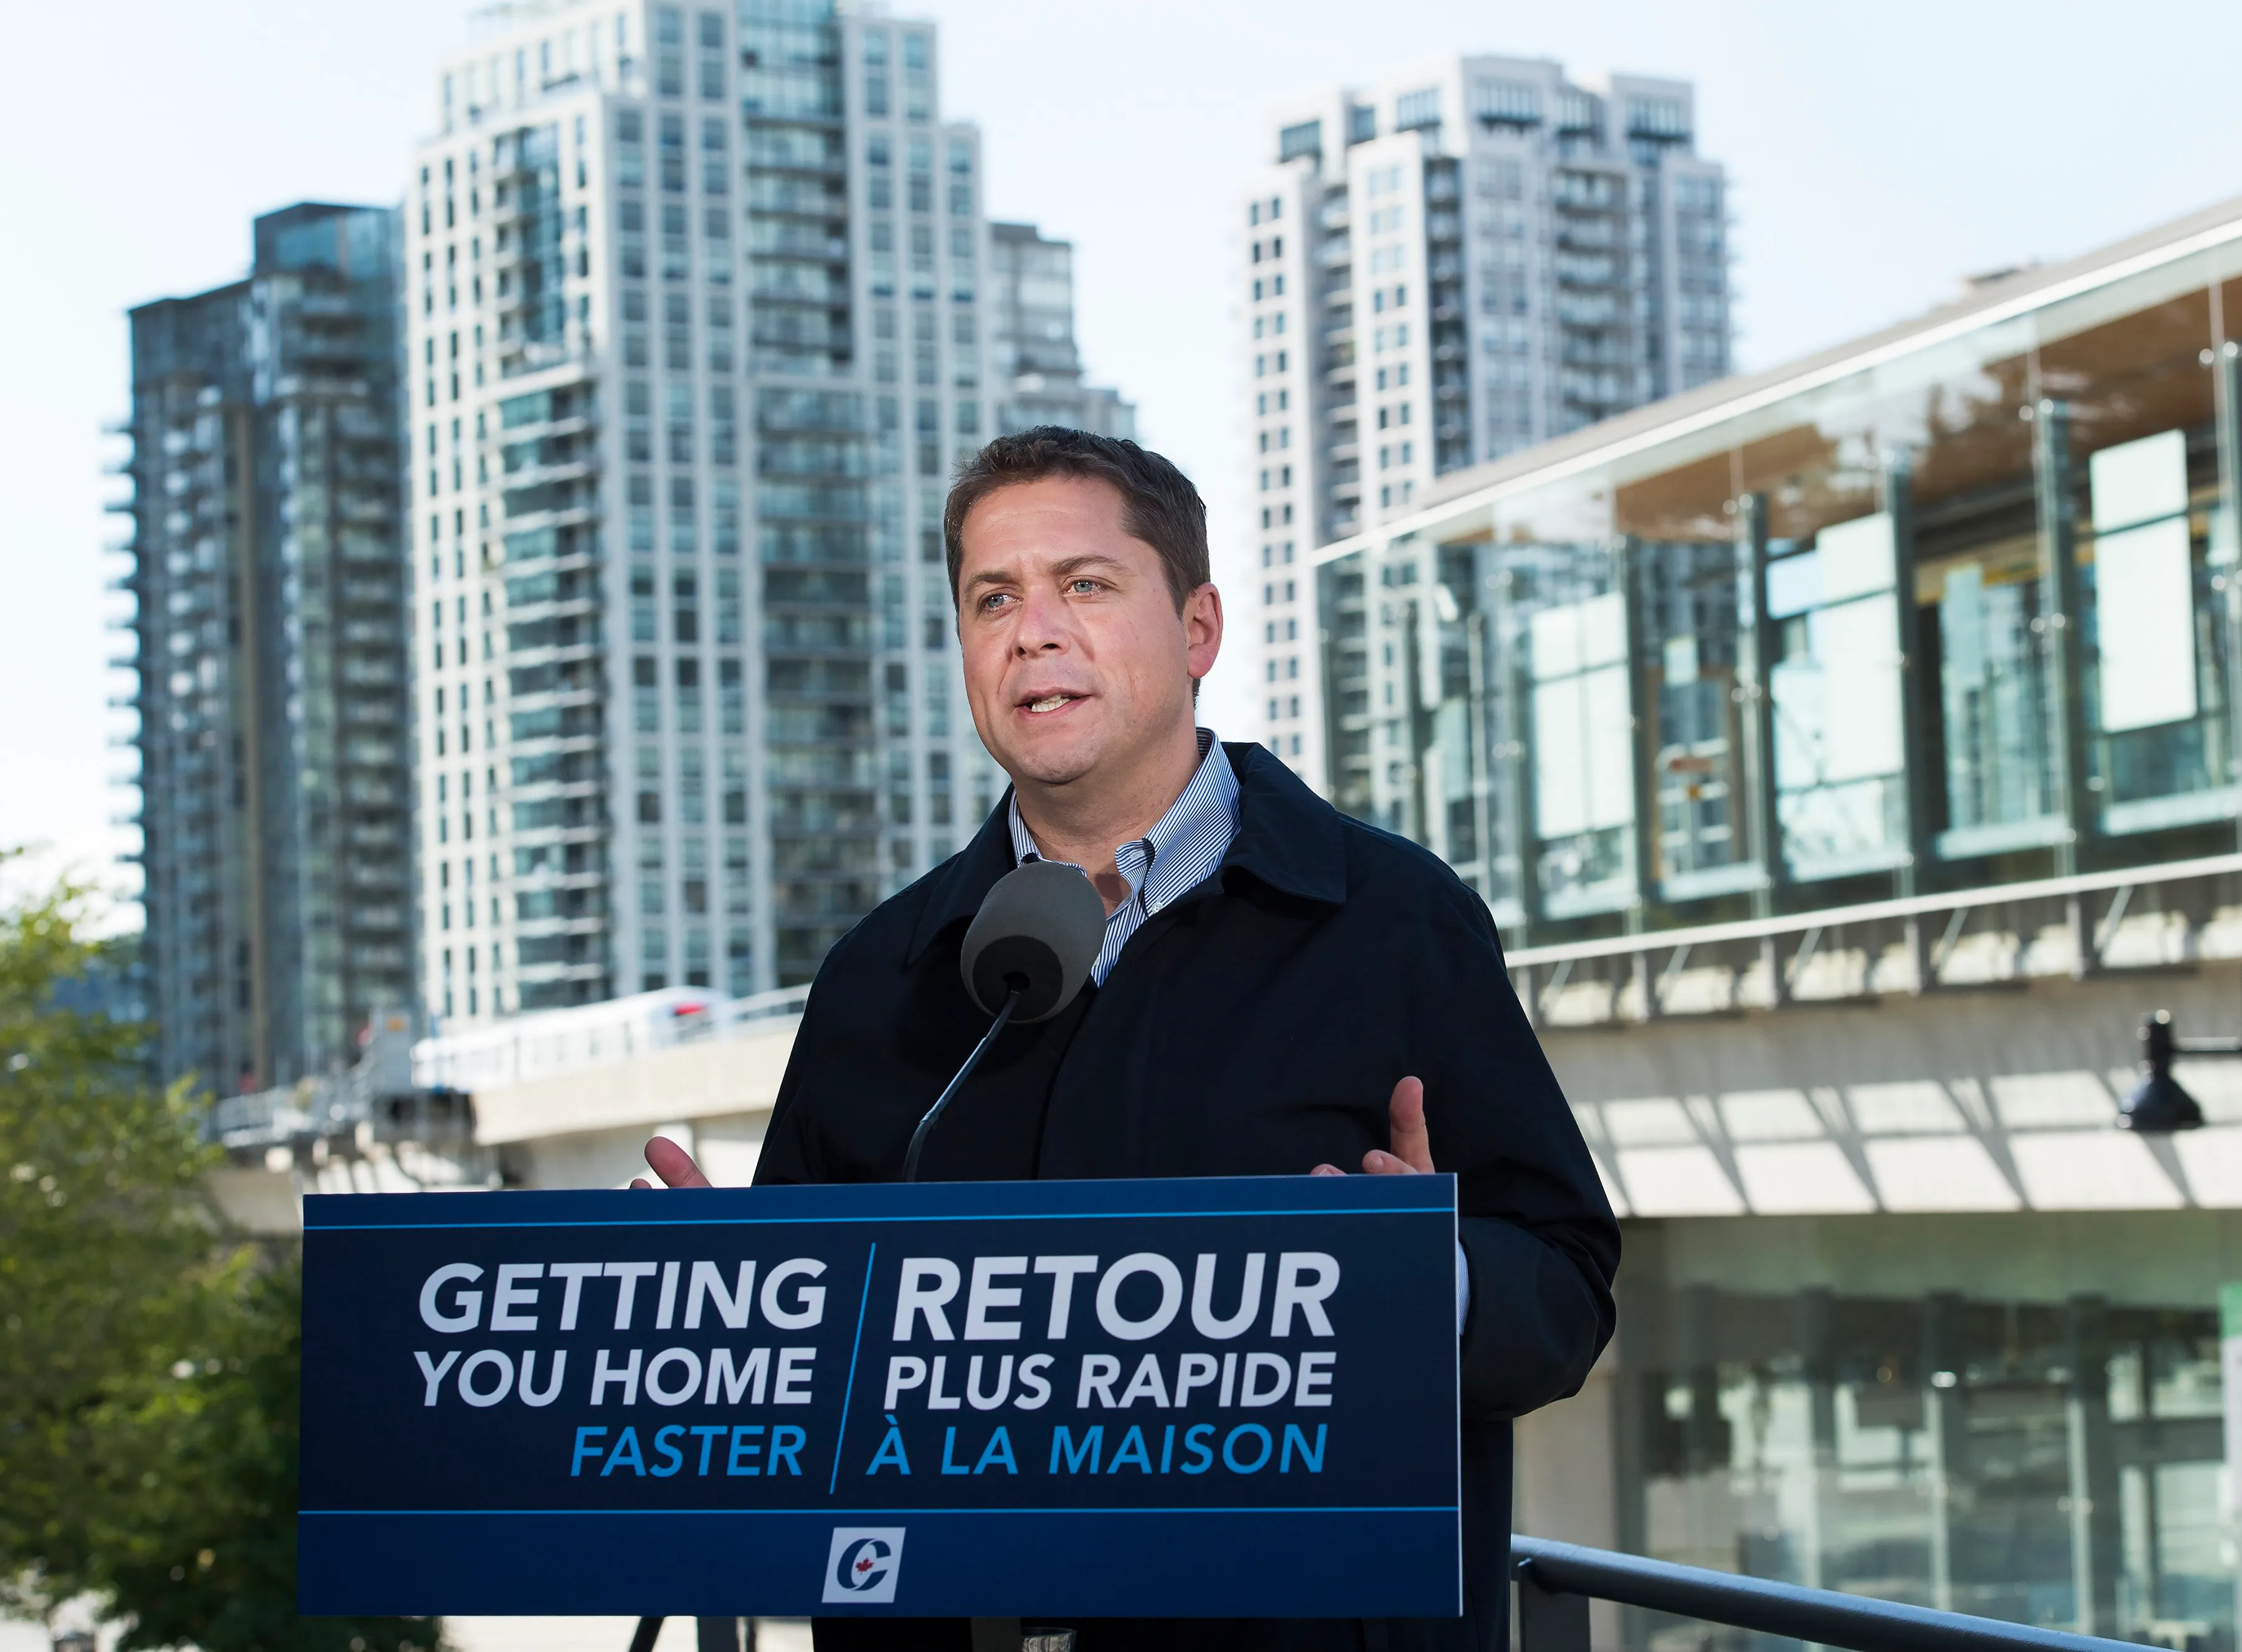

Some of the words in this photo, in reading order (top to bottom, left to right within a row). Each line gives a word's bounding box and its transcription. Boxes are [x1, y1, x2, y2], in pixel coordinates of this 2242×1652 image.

[420, 1258, 827, 1333] GETTING
[892, 1252, 1340, 1341] RETOUR
[414, 1349, 567, 1407] YOU
[590, 1348, 816, 1406] HOME
[884, 1354, 1054, 1410] PLUS
[1077, 1352, 1336, 1408] RAPIDE
[570, 1425, 806, 1477] FASTER
[866, 1414, 911, 1475] À
[940, 1425, 1018, 1475] LA
[1049, 1423, 1328, 1474] MAISON
